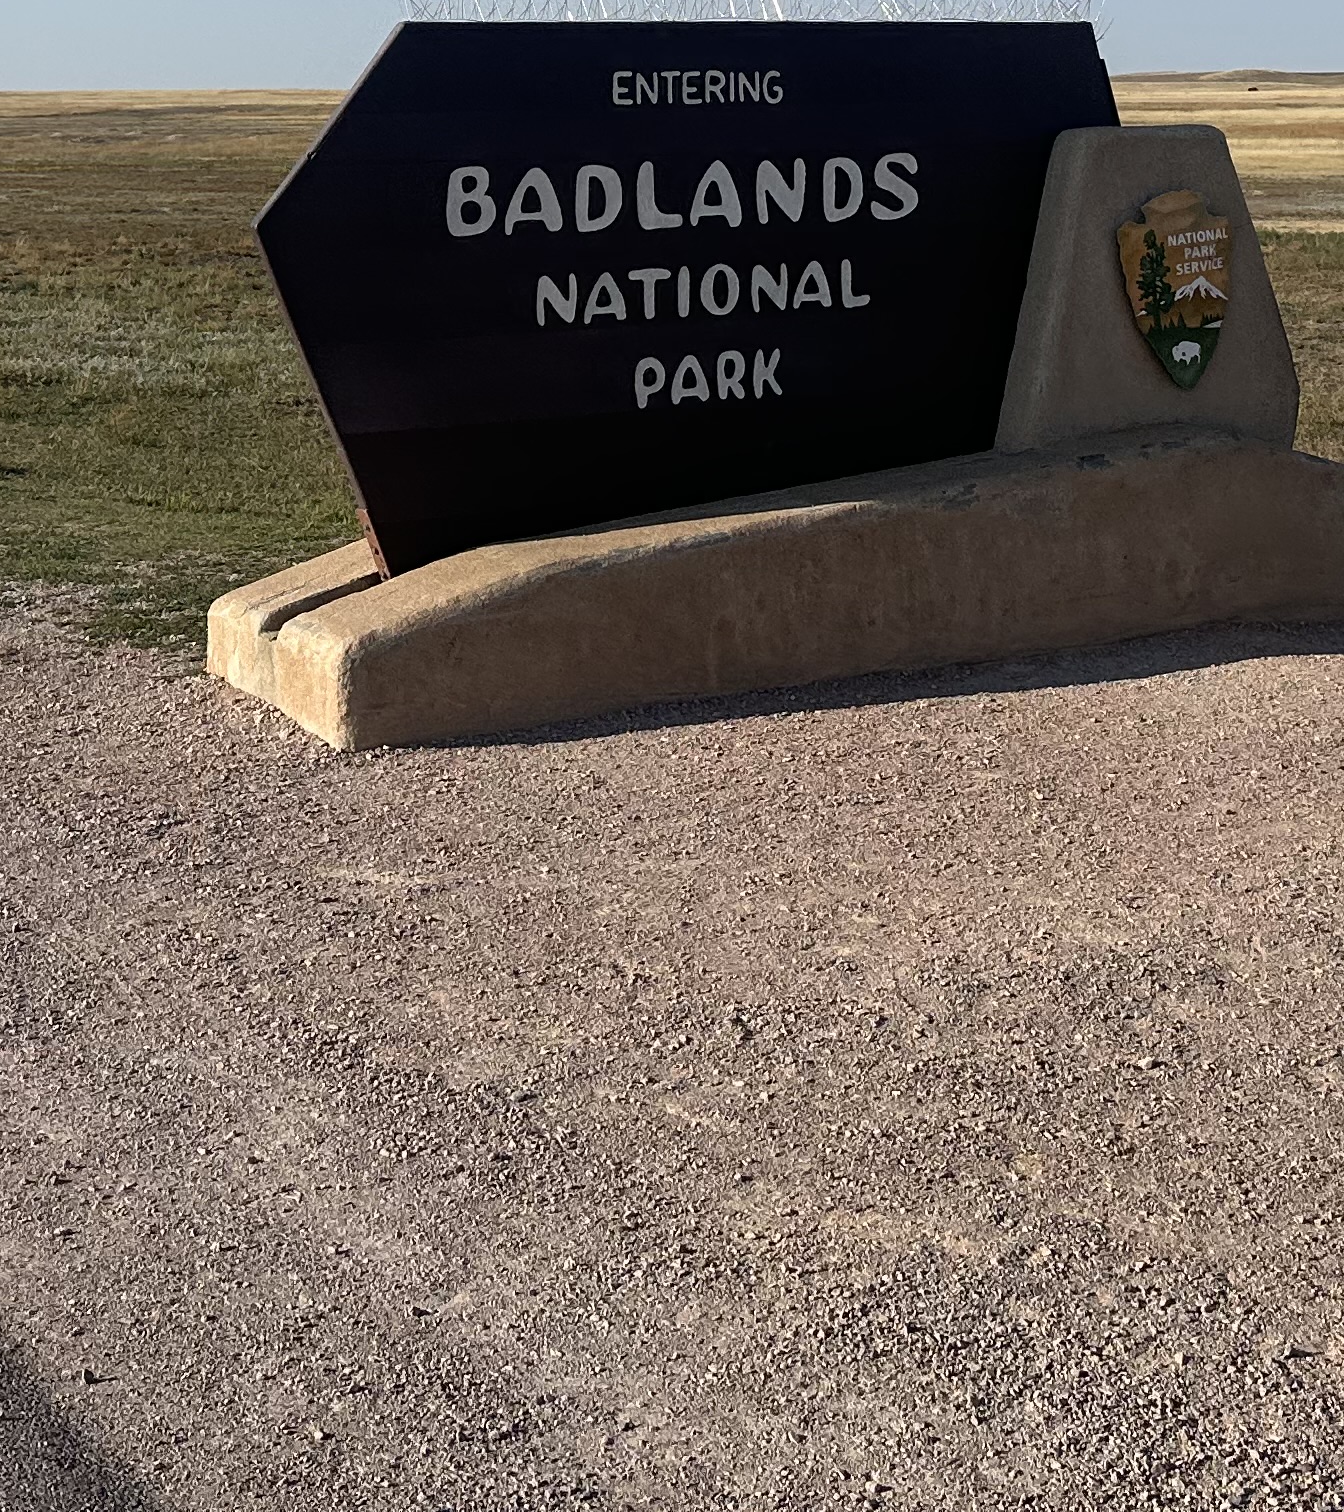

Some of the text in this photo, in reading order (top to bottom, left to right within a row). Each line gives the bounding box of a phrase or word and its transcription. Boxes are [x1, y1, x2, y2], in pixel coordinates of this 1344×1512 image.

[612, 69, 784, 106] ENTERING
[445, 152, 920, 237] BADLANDS
[1167, 227, 1229, 247] NATIONAL
[1184, 243, 1217, 260] PARK
[1175, 257, 1224, 276] SERVICE
[536, 258, 871, 327] NATIONAL
[634, 347, 783, 409] PARK
